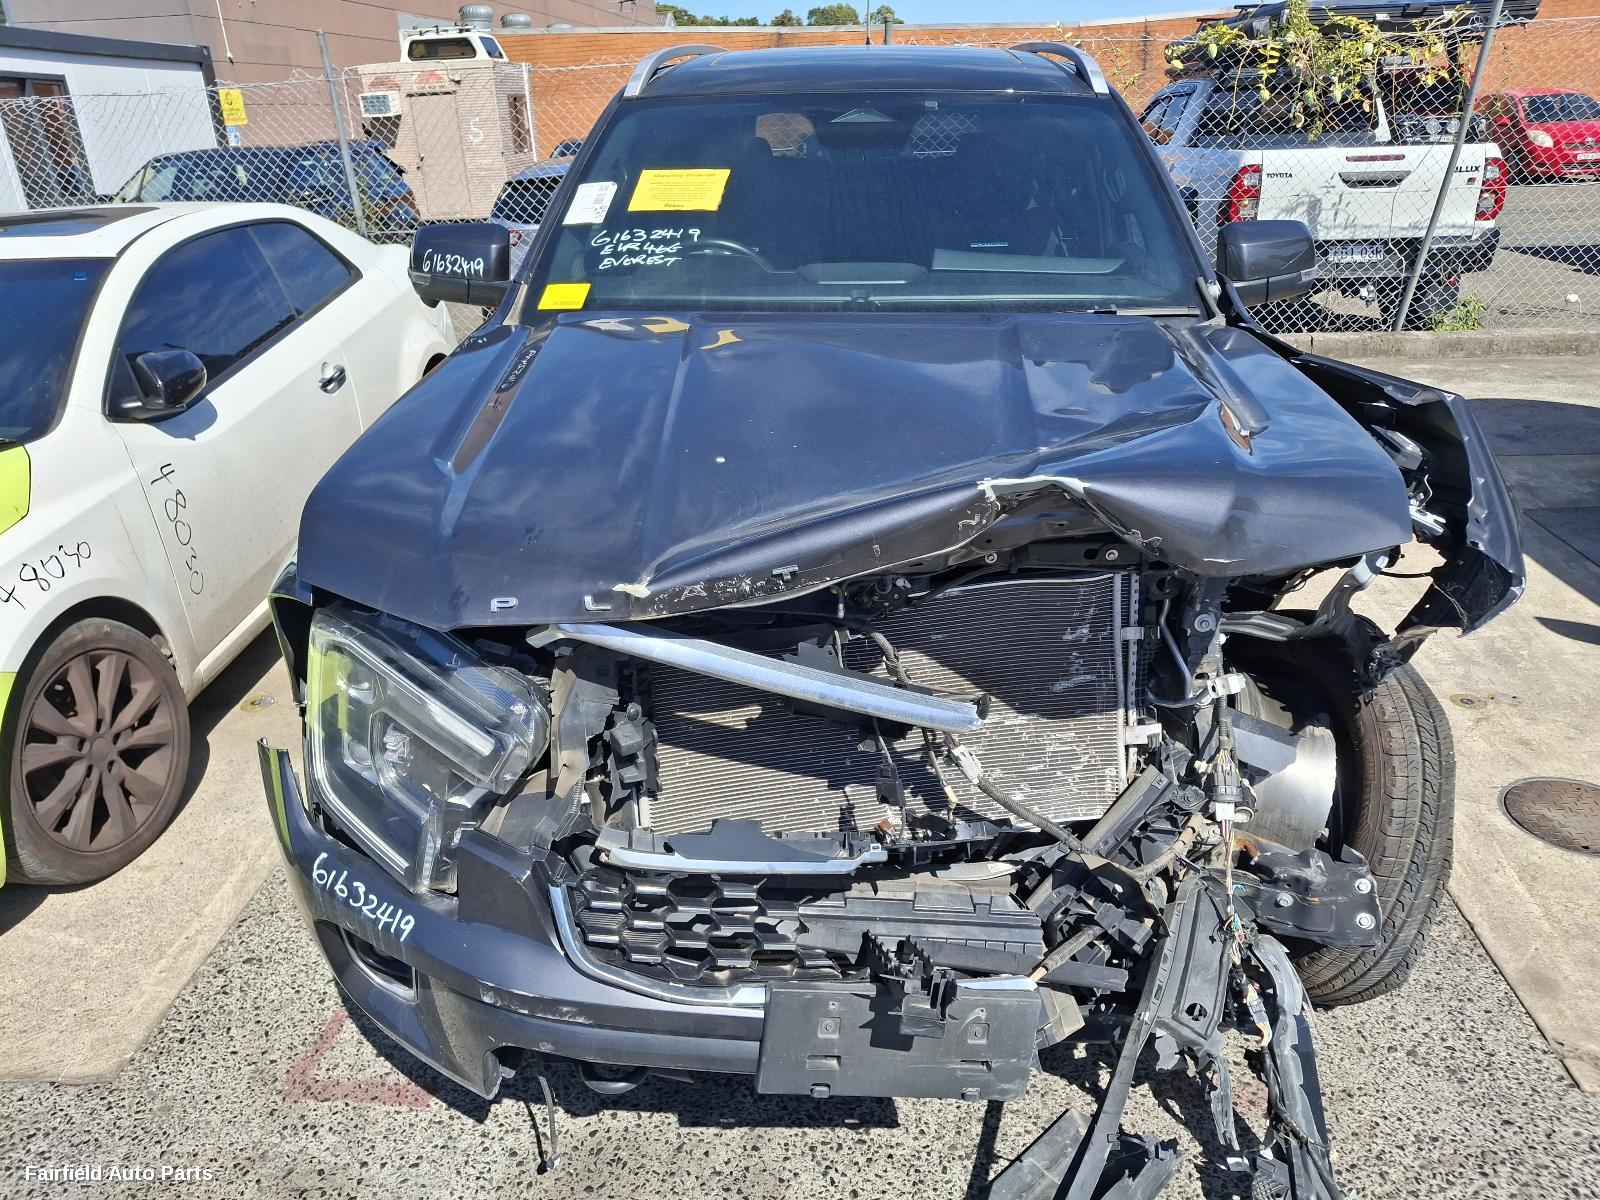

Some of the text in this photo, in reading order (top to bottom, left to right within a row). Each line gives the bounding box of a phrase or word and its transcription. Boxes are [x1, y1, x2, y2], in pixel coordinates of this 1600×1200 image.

[1454, 165, 1481, 173] ILUX
[591, 227, 701, 247] 61632419
[422, 248, 484, 280] 61632419
[598, 253, 683, 270] EVEREST
[312, 852, 416, 943] 61632419
